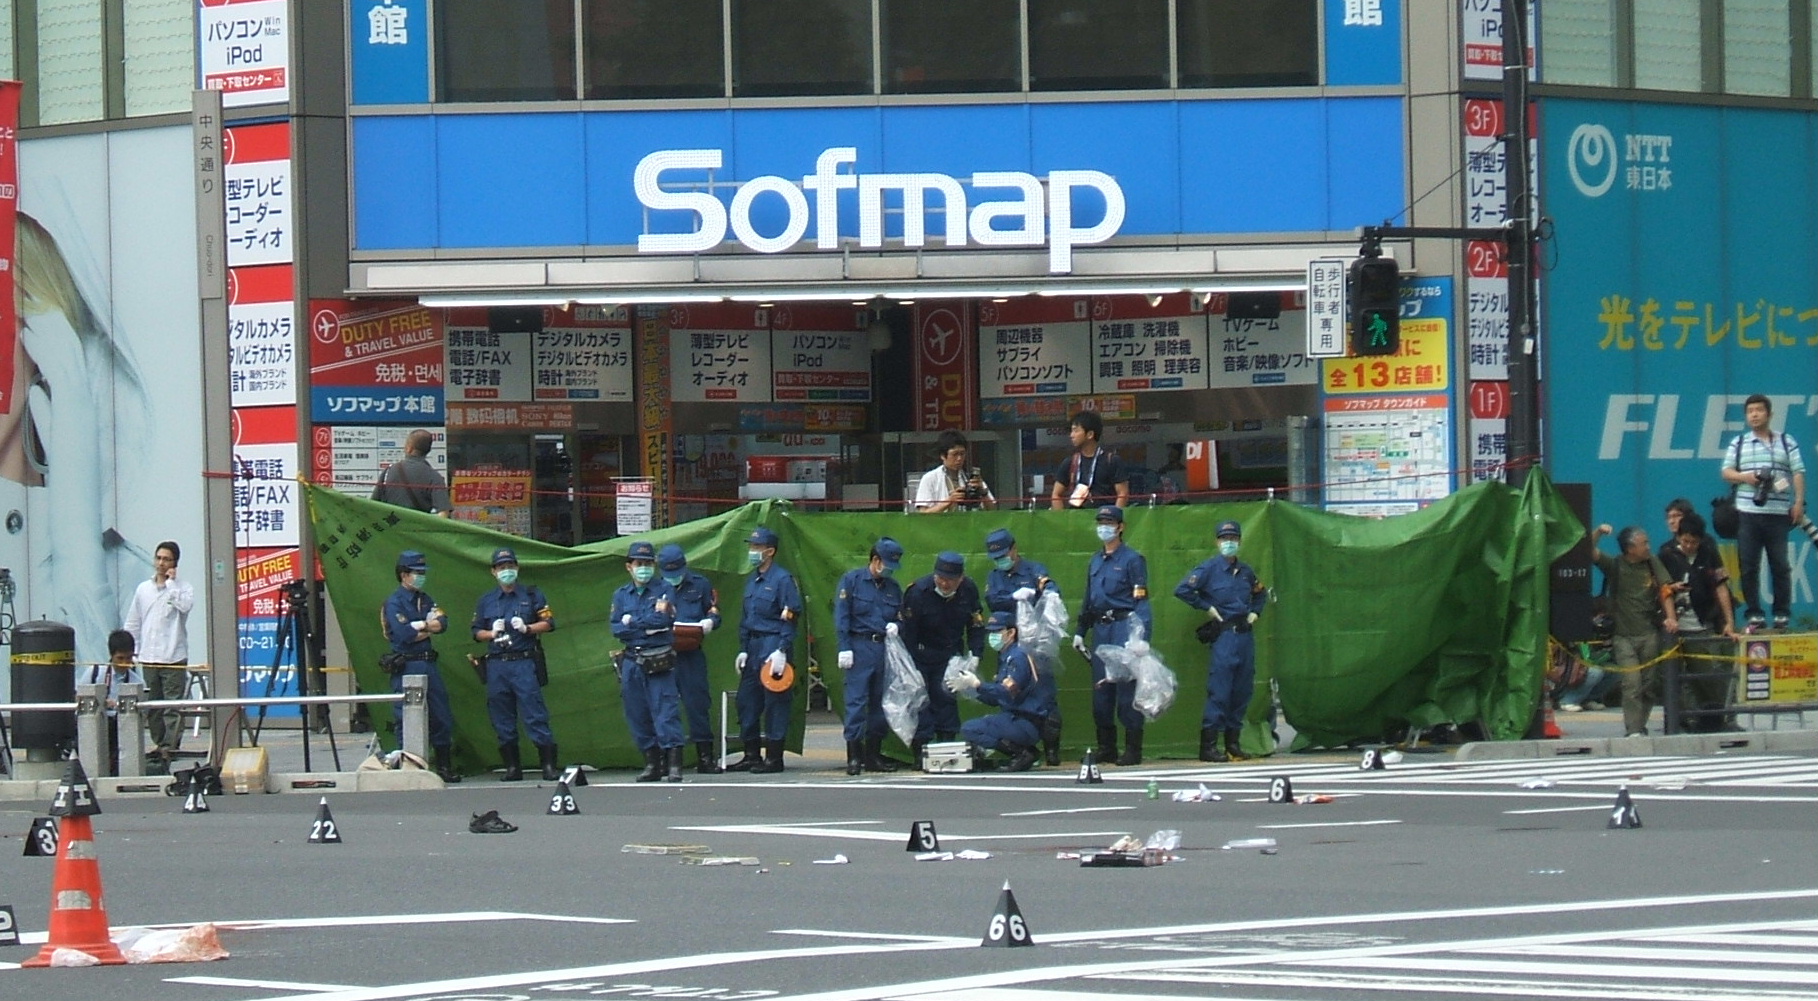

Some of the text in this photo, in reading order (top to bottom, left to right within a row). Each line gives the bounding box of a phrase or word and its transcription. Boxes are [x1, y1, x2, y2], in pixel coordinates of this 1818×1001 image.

[208, 20, 262, 42] パソコン
[264, 27, 280, 36] Mac
[368, 0, 407, 44] 館
[226, 44, 262, 65] iPod
[1471, 106, 1490, 130] 3F
[200, 115, 214, 194] 中央通り
[1626, 136, 1672, 162] NTT
[226, 176, 284, 201] 型テレビ
[1626, 167, 1672, 190] 東日本
[634, 147, 1125, 273] Sofmap
[1474, 246, 1493, 272] 2F
[1313, 268, 1325, 314] 自転車
[1328, 268, 1341, 314] 歩行者
[341, 322, 384, 344] DUTY
[389, 310, 432, 333] FREE
[996, 328, 1043, 345] 周辺機器
[1098, 321, 1180, 339] 冷蔵庫 洗濯機
[1320, 318, 1333, 348] 専用
[344, 328, 434, 358] & TRAVEL VALUE
[448, 330, 500, 347] 携帯電話
[538, 332, 620, 348] デジタルカメラ
[691, 334, 749, 350] 薄型テレビ
[793, 334, 838, 350] パソコン
[1224, 338, 1260, 352] ホビー
[450, 351, 512, 366] 電話/FAX
[538, 352, 628, 366] デジタルビデオカメラ
[996, 346, 1042, 362] サプライ
[1100, 340, 1192, 358] エアコン 掃除機
[1471, 344, 1500, 366] 時計
[692, 352, 749, 367] レコーダー
[793, 354, 823, 367] iPod
[1100, 358, 1201, 378] 調理 照明 理美容
[1223, 354, 1314, 372] 音楽/映像ソフト
[450, 369, 501, 386] 電子辞書
[538, 370, 564, 386] 時計
[692, 371, 748, 386] オーディオ
[997, 364, 1074, 382] パソコンソフト
[327, 395, 436, 414] ソフマップ本館
[941, 373, 962, 426] DU
[1344, 398, 1428, 410] ソフマップ タウンガイド
[1478, 388, 1496, 412] 1F
[238, 564, 261, 583] UTY
[262, 555, 292, 574] FREE
[240, 570, 293, 594] TRAVEL VALUE
[1361, 750, 1375, 769] 8
[564, 768, 578, 784] 7
[1272, 778, 1284, 802] 6
[38, 828, 57, 854] 3
[918, 822, 936, 850] 5
